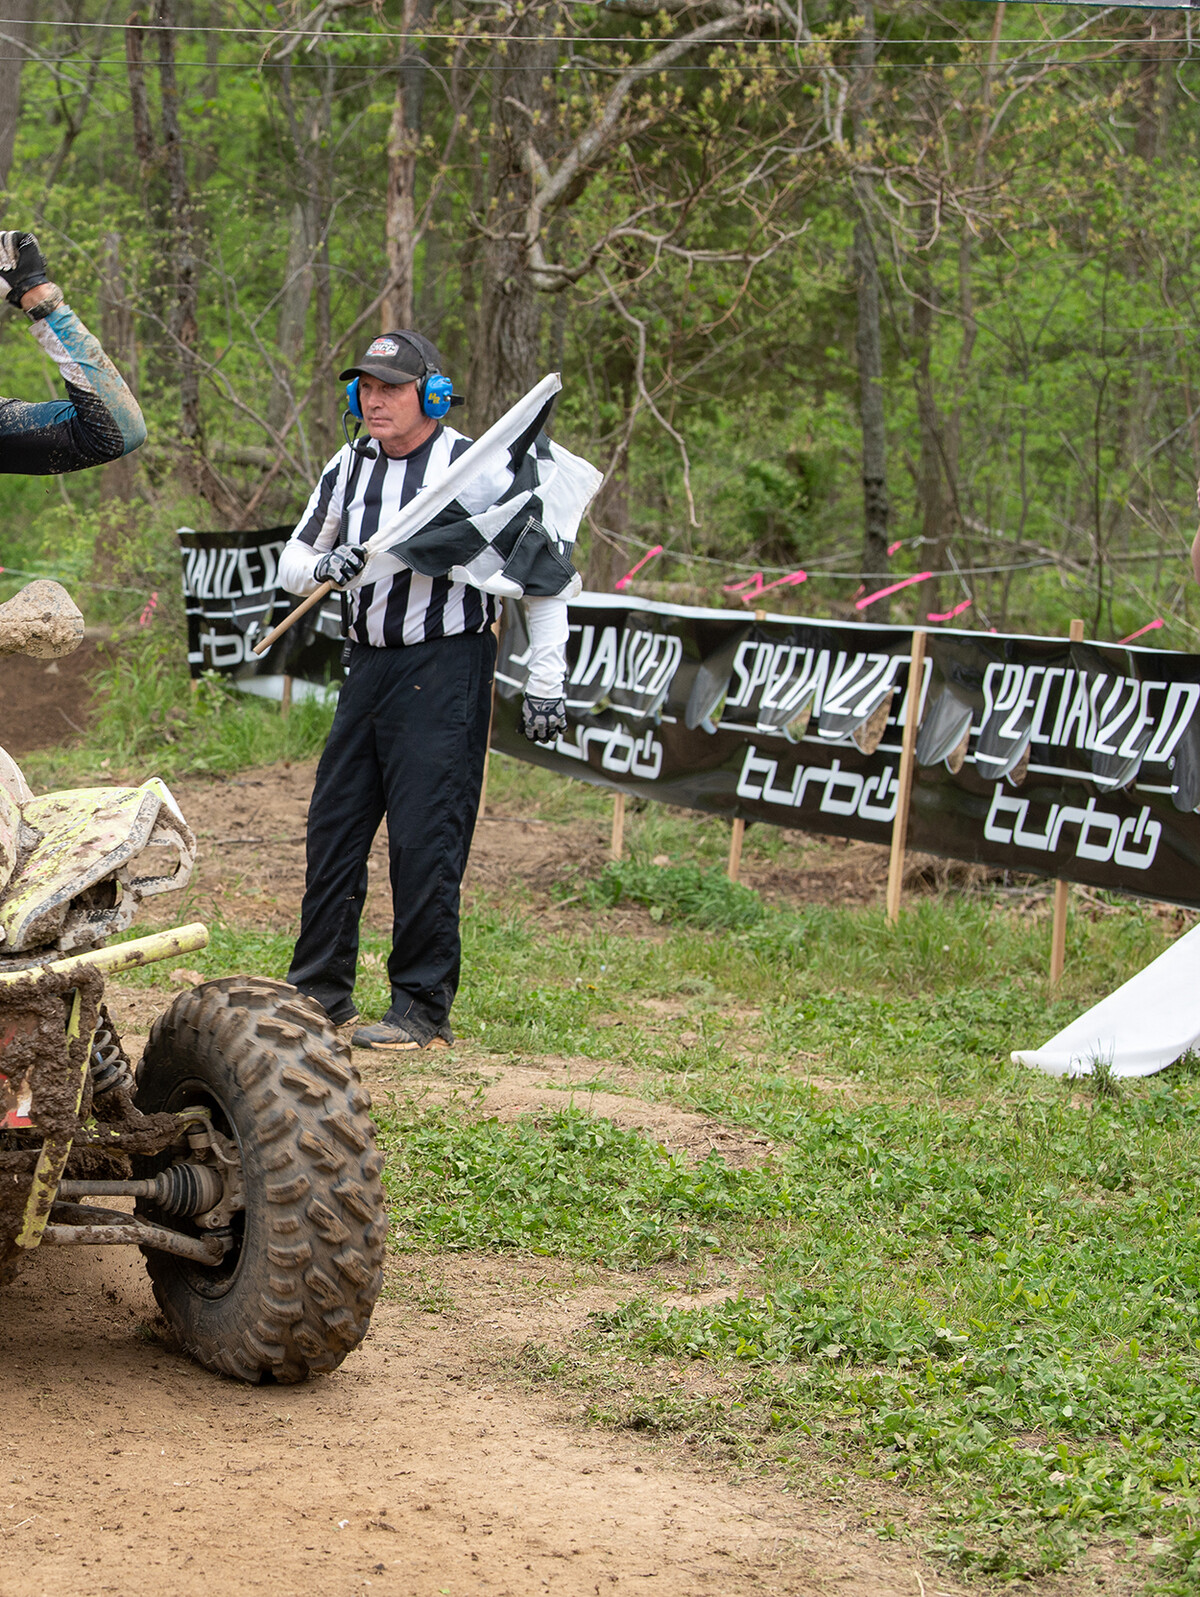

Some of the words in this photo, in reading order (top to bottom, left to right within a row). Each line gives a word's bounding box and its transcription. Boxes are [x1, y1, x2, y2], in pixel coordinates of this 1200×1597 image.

[970, 662, 1200, 763] SPECIALIZED
[736, 746, 900, 823] turbo
[984, 783, 1162, 870] turbo
